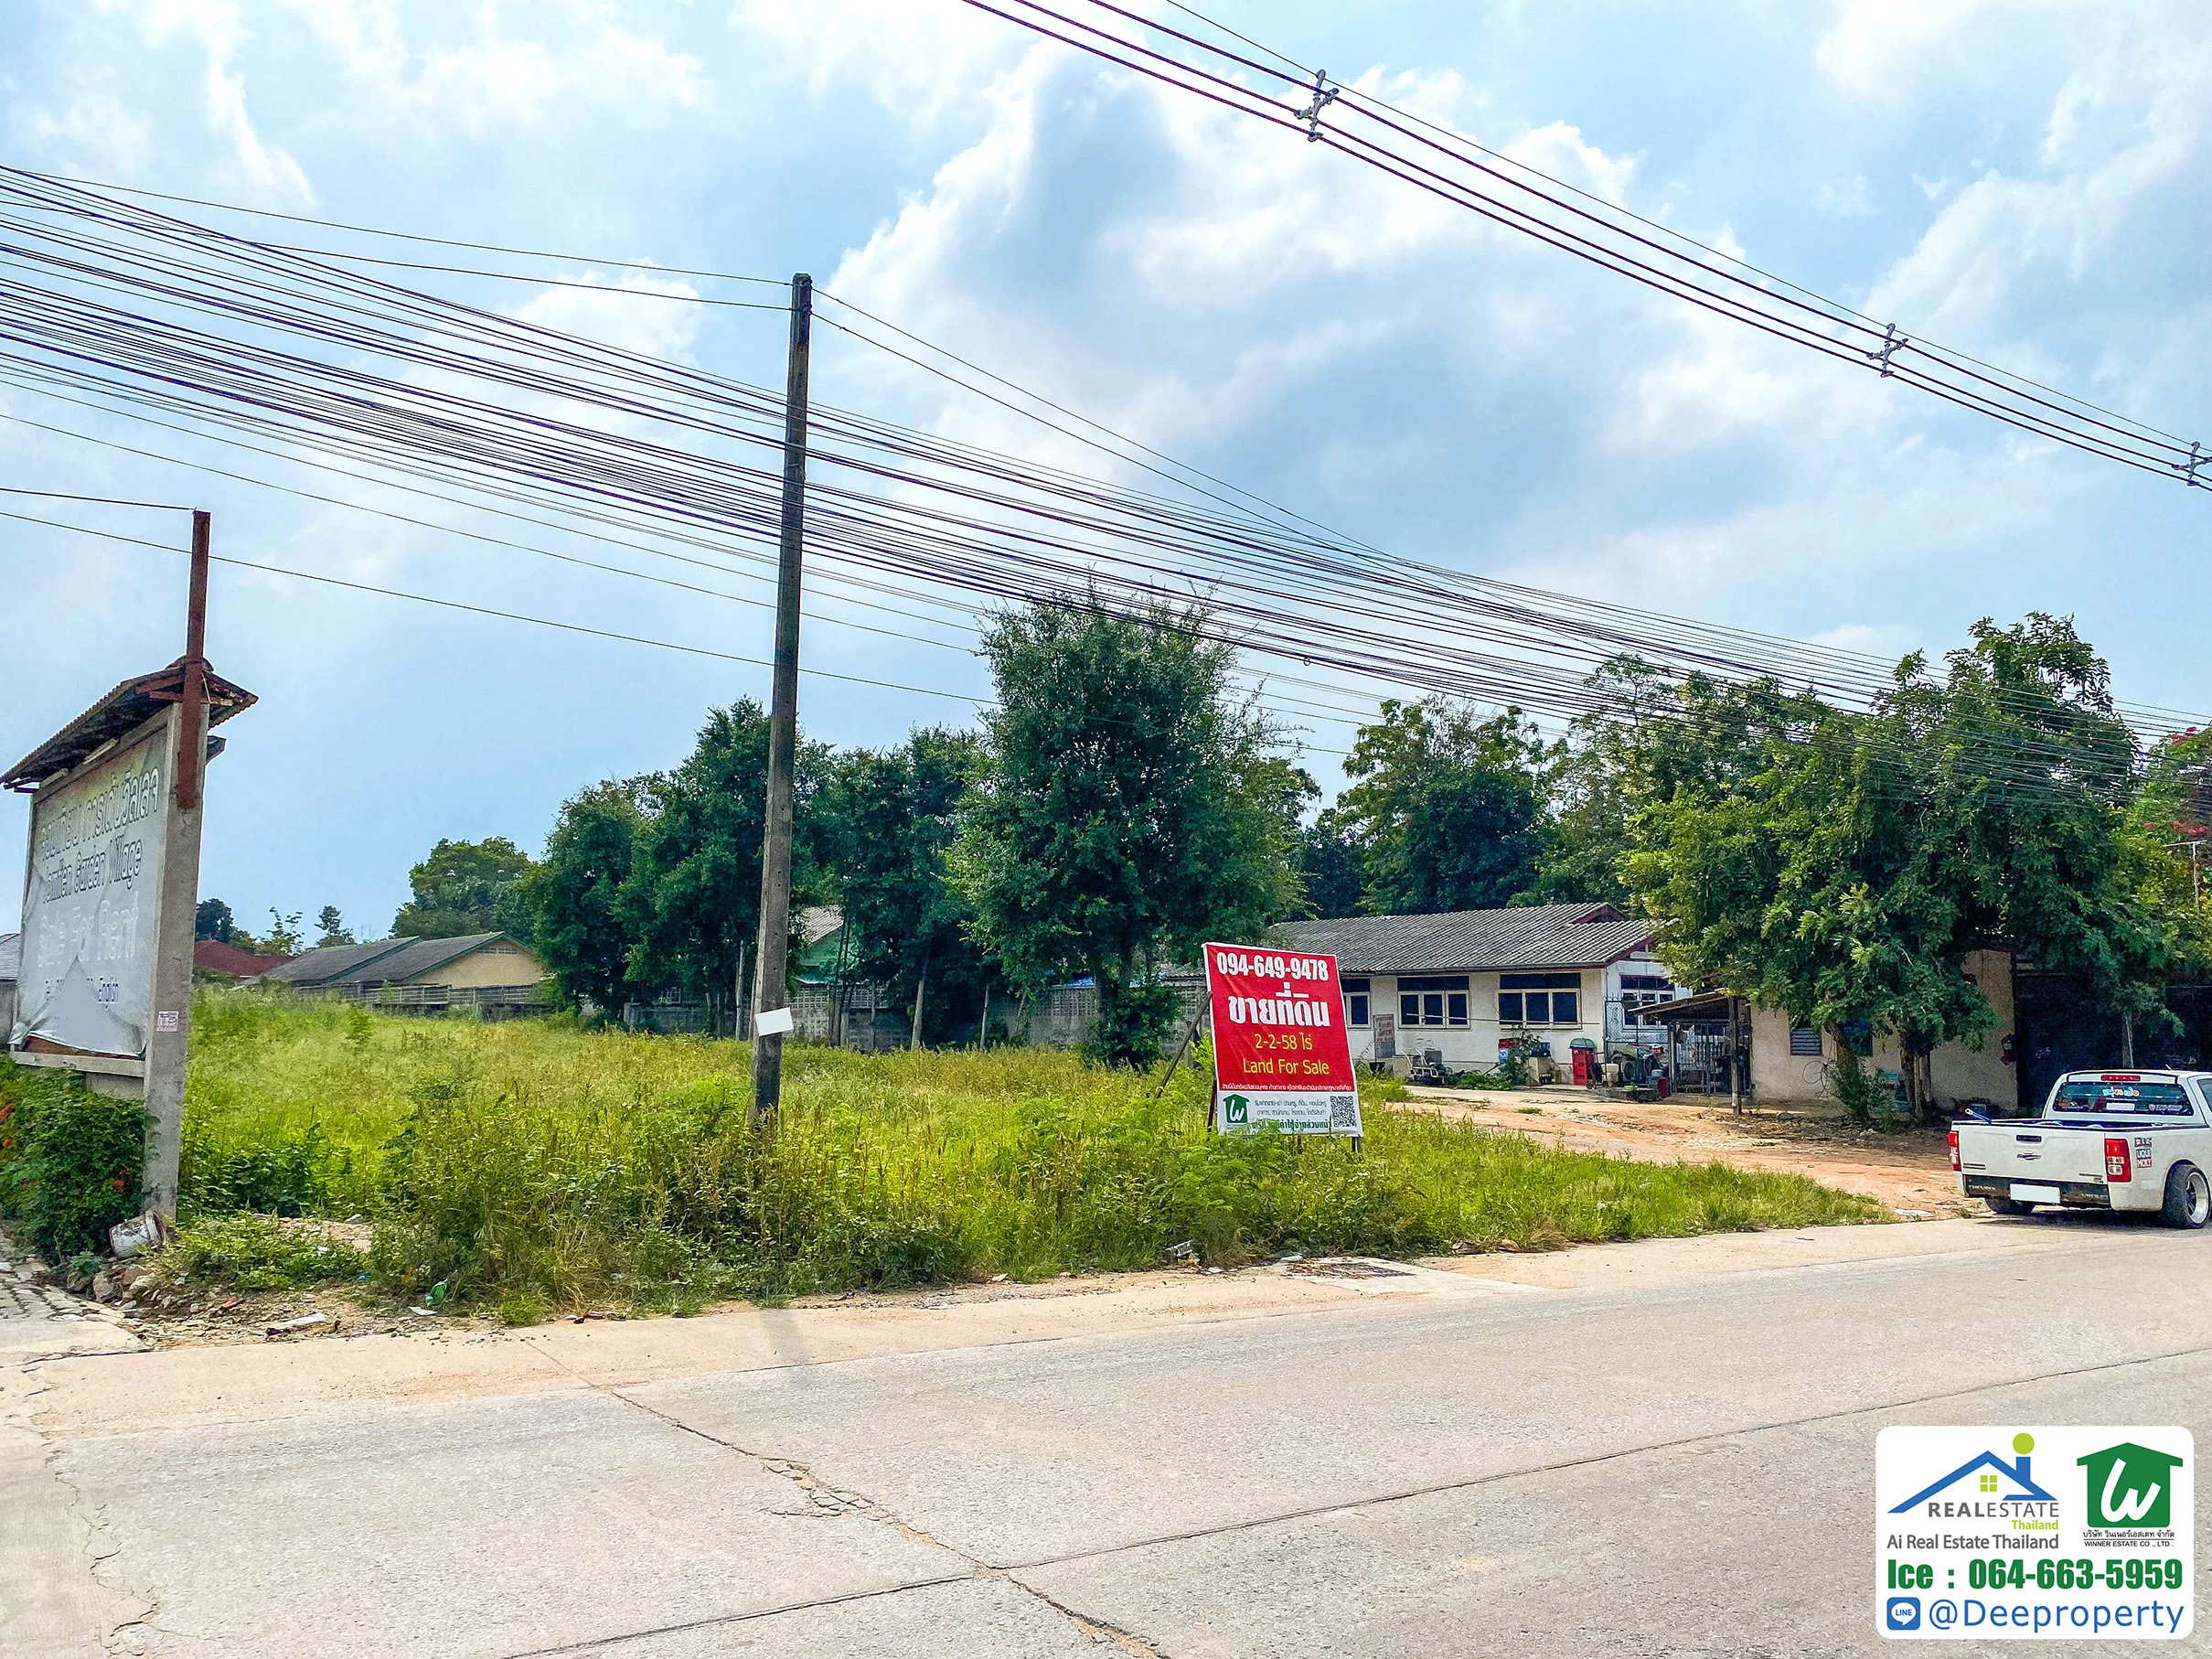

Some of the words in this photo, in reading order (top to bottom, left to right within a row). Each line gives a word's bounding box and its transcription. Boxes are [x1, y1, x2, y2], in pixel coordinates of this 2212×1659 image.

[74, 845, 105, 894] Garden
[108, 833, 142, 890] Village
[97, 891, 139, 960] Rent
[1216, 952, 1329, 981] 094-649-9478
[1227, 981, 1330, 1027] ขายที่ดิน
[1255, 1033, 1298, 1050] 2-2-58
[1298, 1032, 1313, 1050] ไร่
[1243, 1057, 1274, 1074] Land
[1278, 1059, 1298, 1074] For
[1302, 1059, 1330, 1075] Sale
